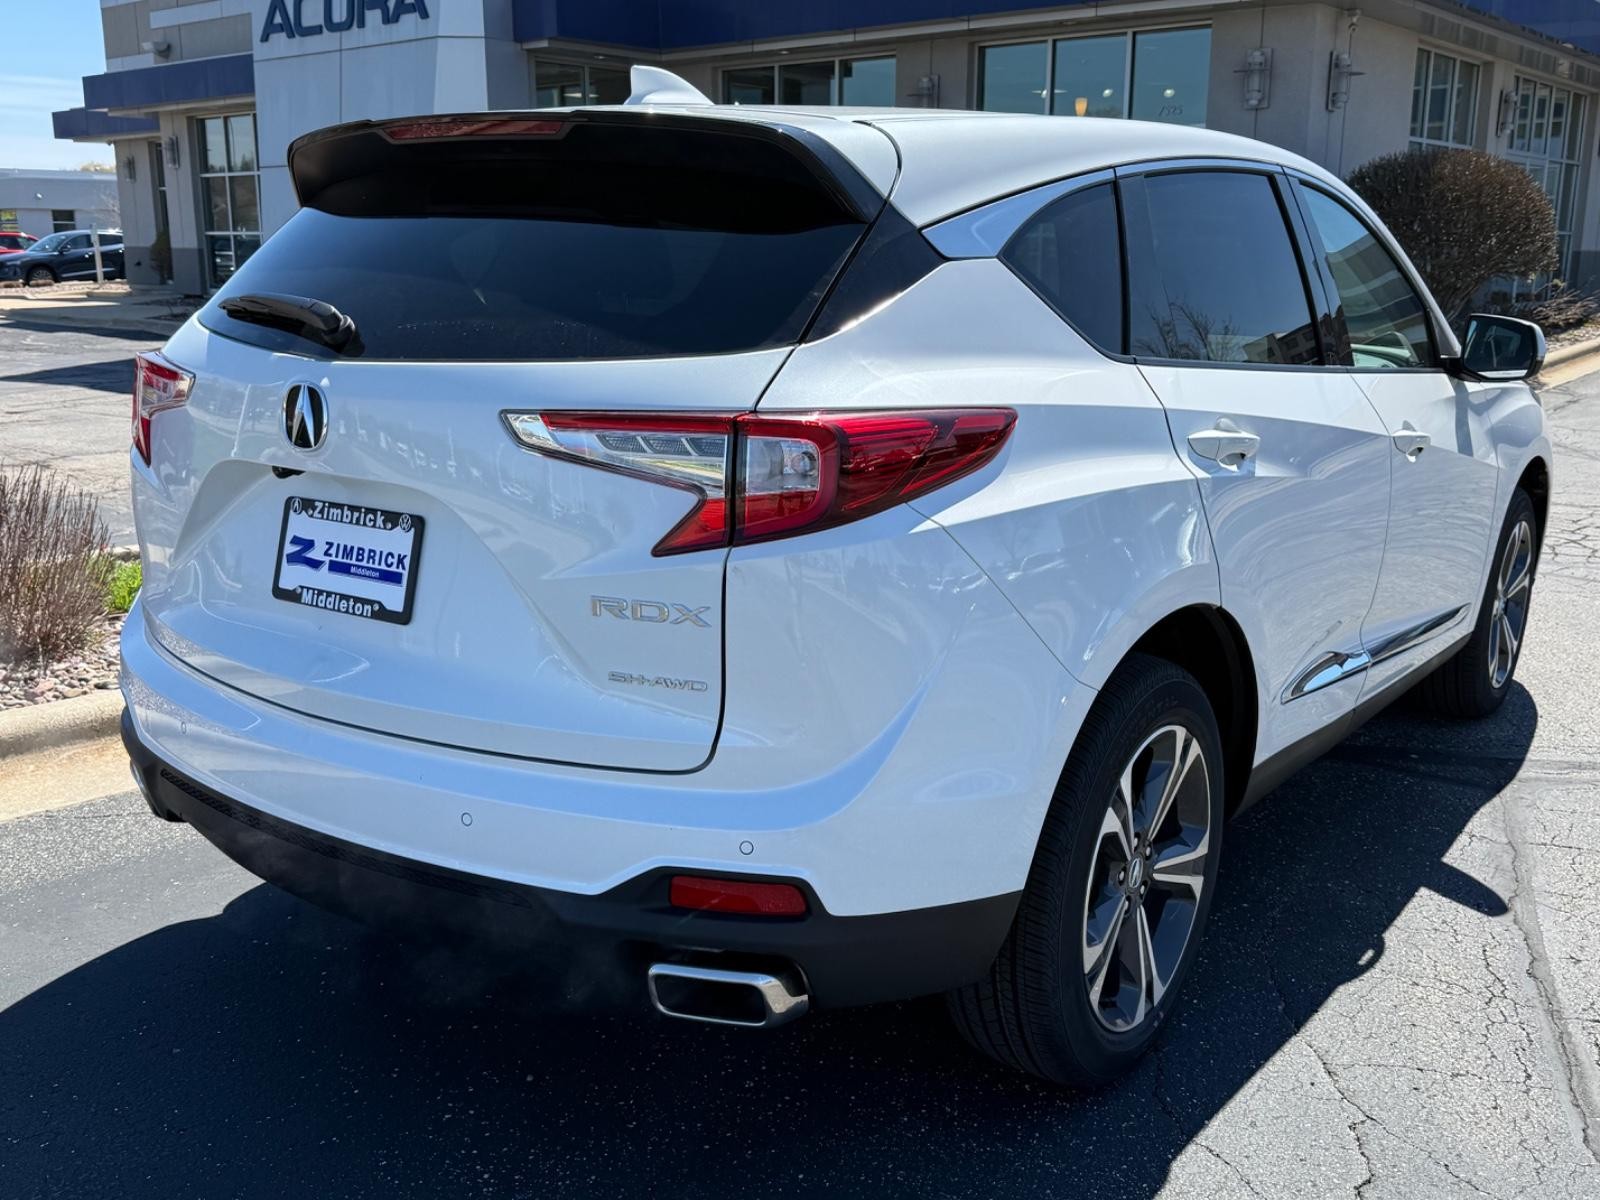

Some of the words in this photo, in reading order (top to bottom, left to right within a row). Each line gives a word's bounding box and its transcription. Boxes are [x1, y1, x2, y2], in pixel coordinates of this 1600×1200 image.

[313, 501, 386, 529] Zimbrick
[323, 541, 408, 571] ZIMBRICK
[350, 565, 380, 578] Middleton
[301, 587, 373, 617] Middleton
[590, 594, 713, 628] RDX
[607, 671, 708, 692] SH-AWD
